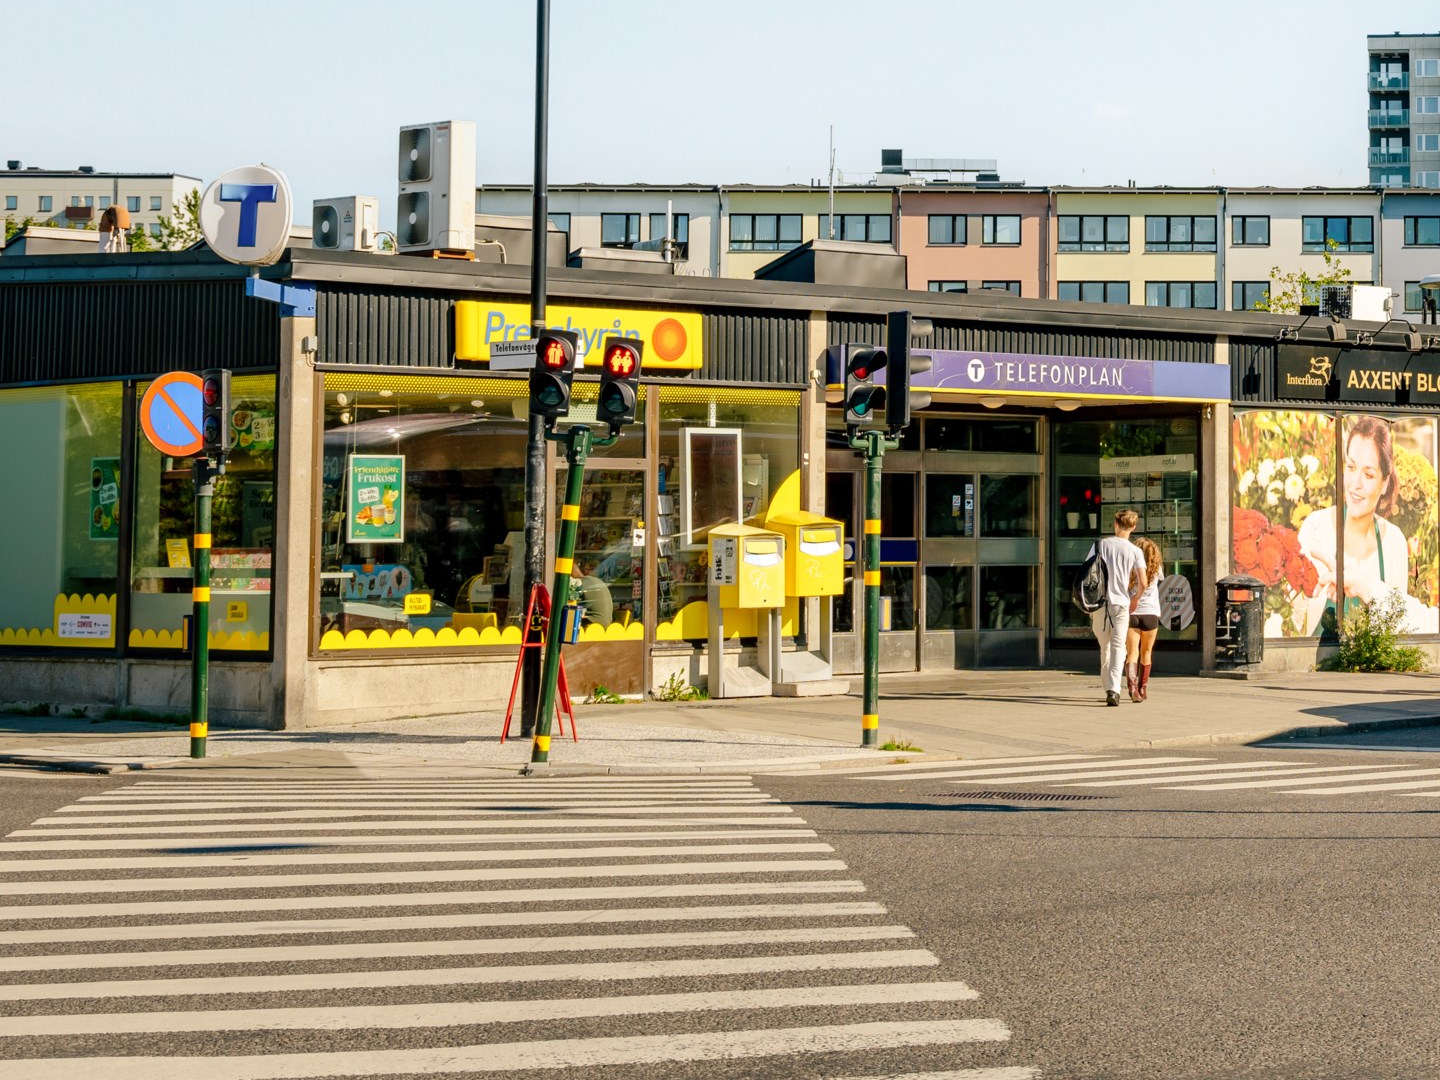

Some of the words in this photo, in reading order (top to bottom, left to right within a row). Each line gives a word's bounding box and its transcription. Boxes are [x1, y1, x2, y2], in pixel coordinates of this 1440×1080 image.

[219, 182, 279, 248] T
[495, 342, 537, 353] Telefonväge
[995, 362, 1123, 387] TELEFONPLAN
[1286, 373, 1323, 386] Interflora
[1347, 369, 1413, 391] AXXENT
